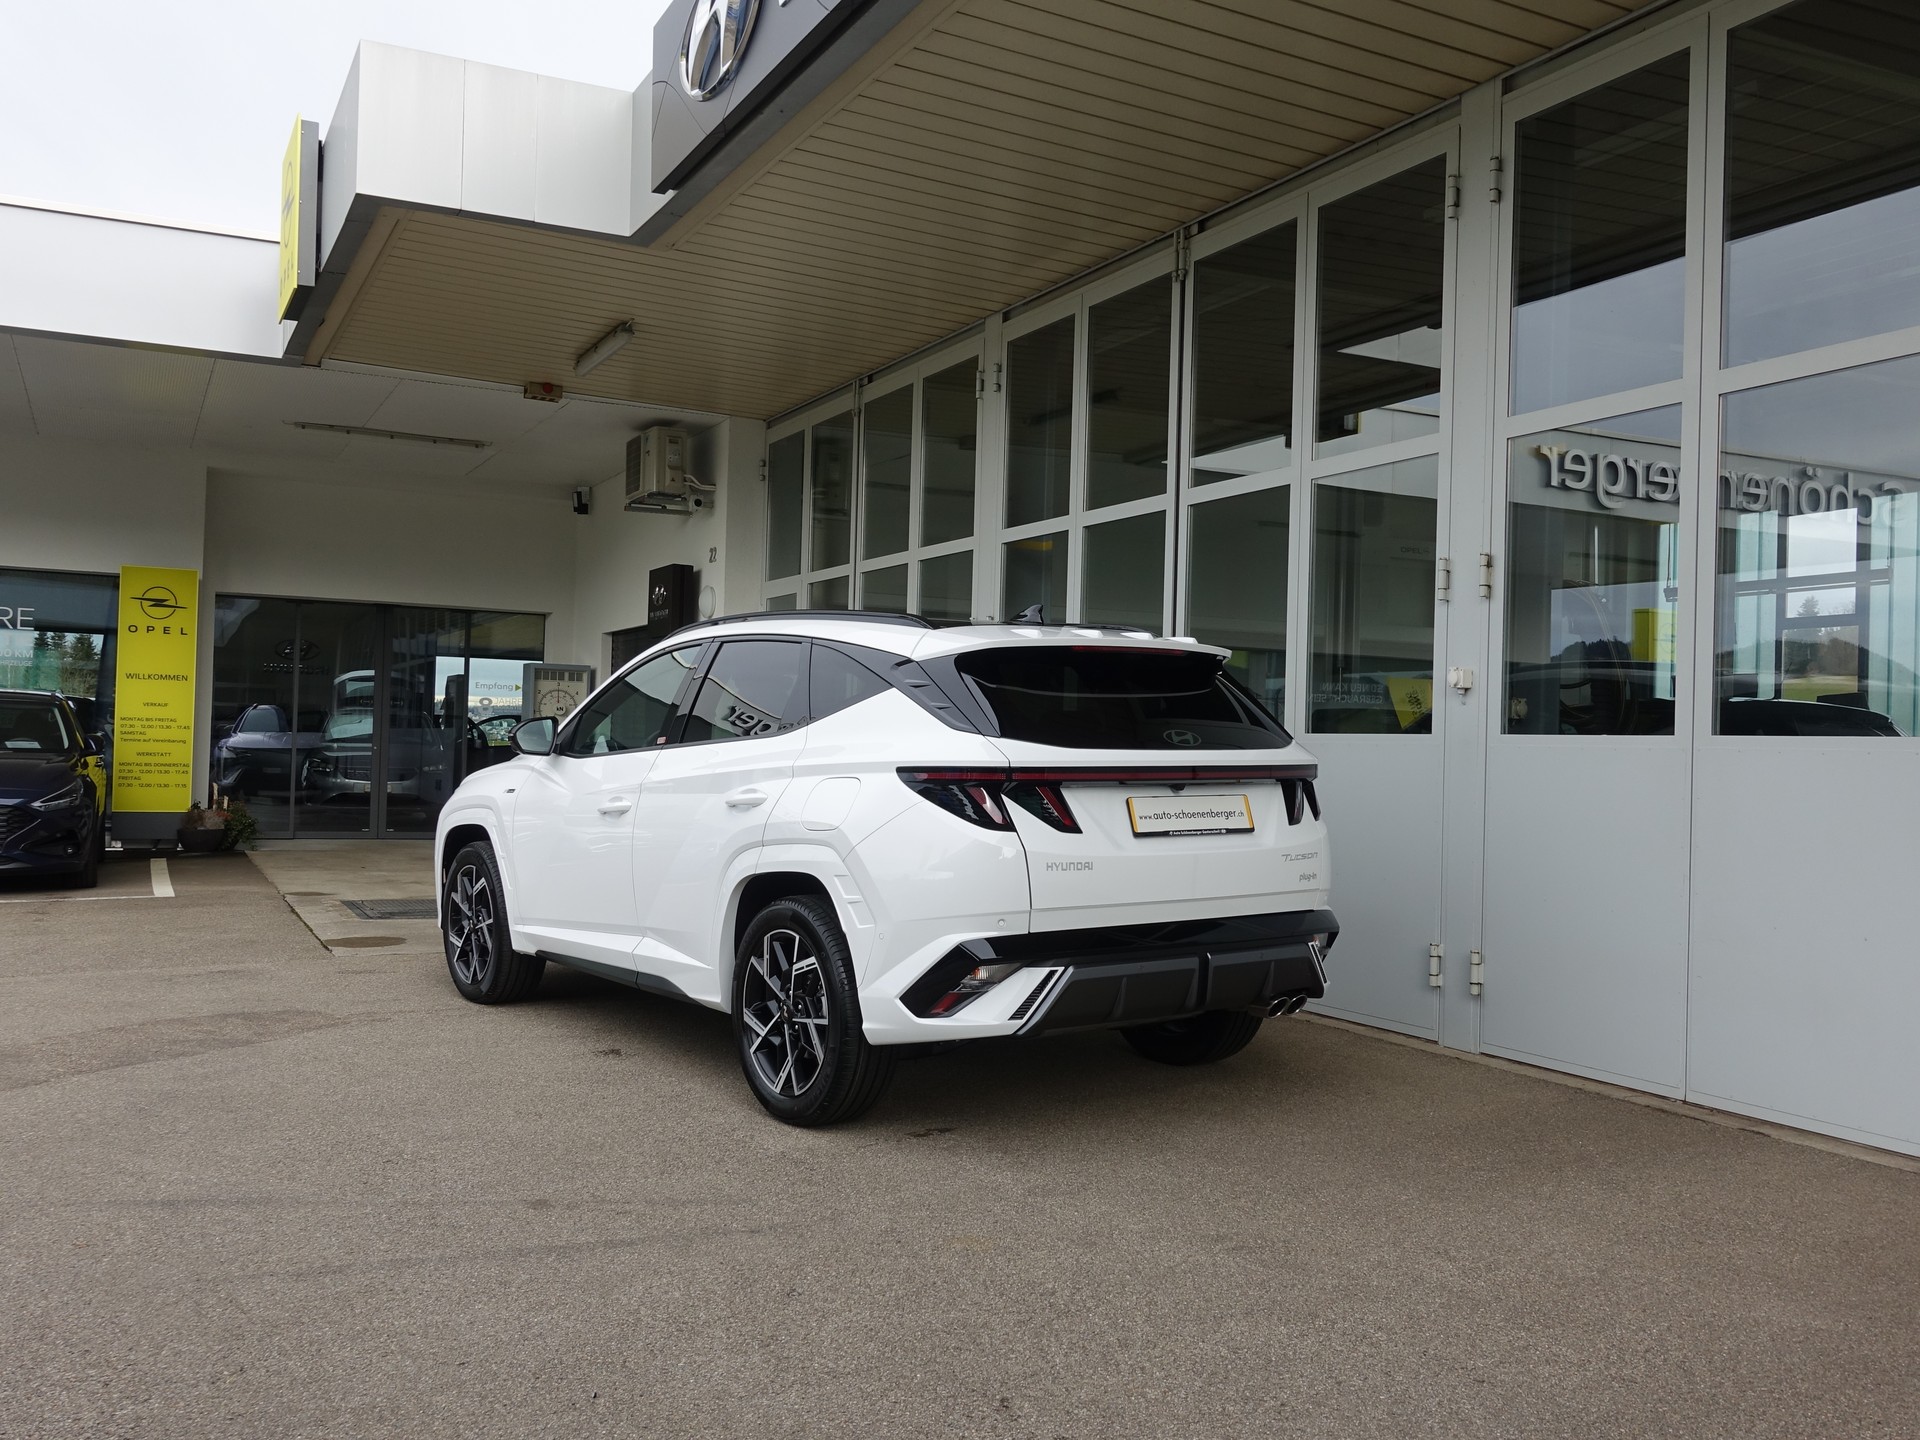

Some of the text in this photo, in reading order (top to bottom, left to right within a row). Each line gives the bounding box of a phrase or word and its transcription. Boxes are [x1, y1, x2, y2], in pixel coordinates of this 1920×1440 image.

[708, 547, 717, 563] 22
[128, 624, 188, 636] OPEL
[14, 649, 34, 658] KM
[125, 673, 188, 682] WILLKOMMEN
[475, 682, 514, 691] Empfang
[1138, 809, 1245, 820] www.auto-schoenenberger.ch
[1046, 861, 1093, 871] HYUNDAI
